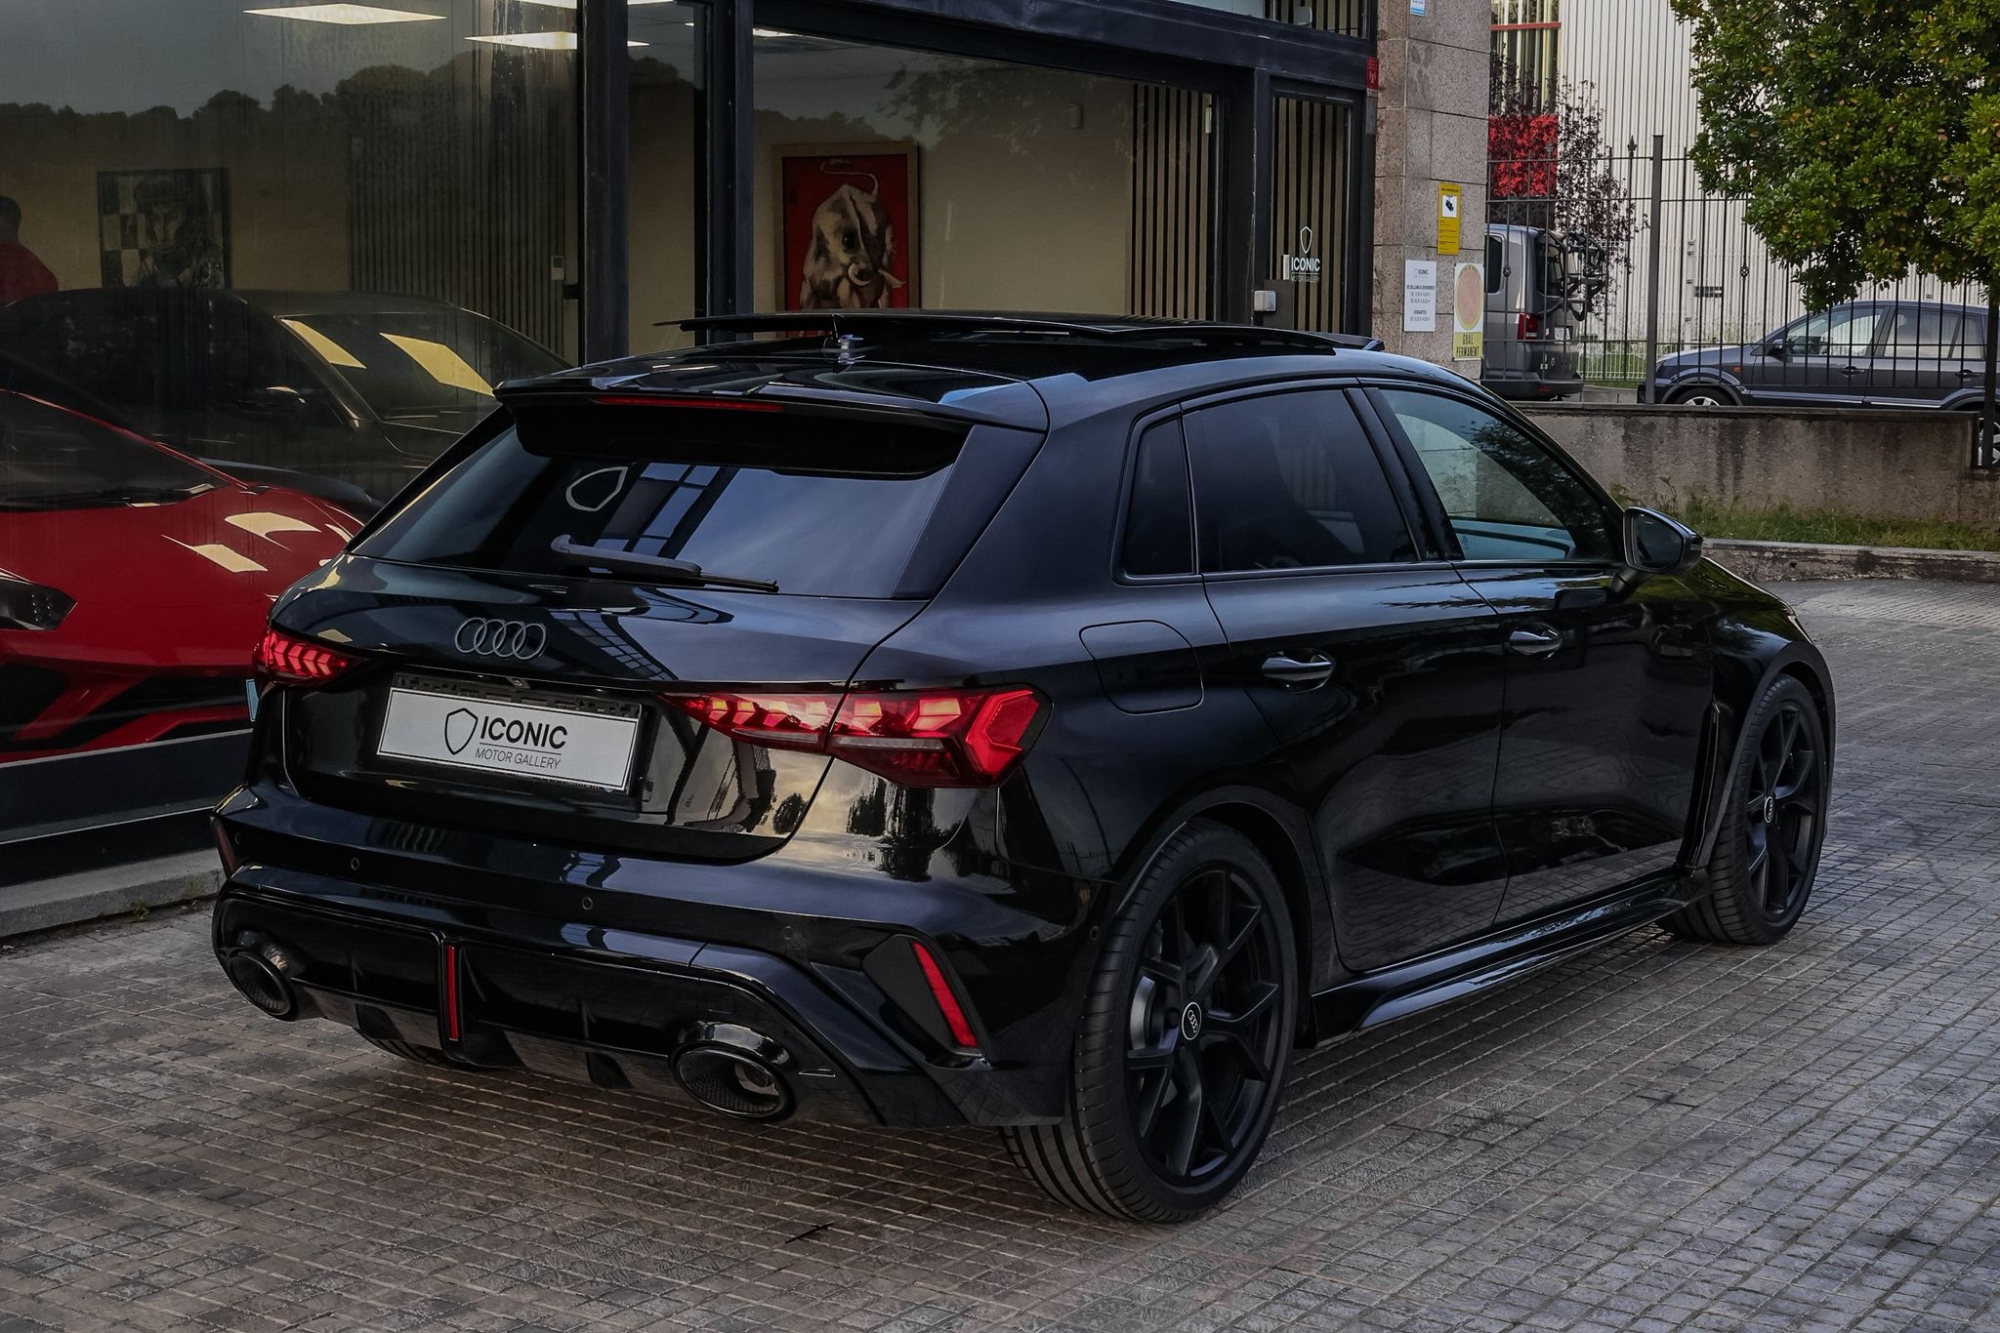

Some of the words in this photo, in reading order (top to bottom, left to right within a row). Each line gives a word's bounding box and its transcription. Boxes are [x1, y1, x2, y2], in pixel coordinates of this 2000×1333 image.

[1291, 257, 1320, 271] ICONIC
[1463, 333, 1474, 345] GUAL
[1456, 346, 1480, 358] PERMANENT
[480, 715, 568, 749] ICONIC
[475, 747, 513, 763] MOTOR
[514, 752, 561, 770] GALLERY
